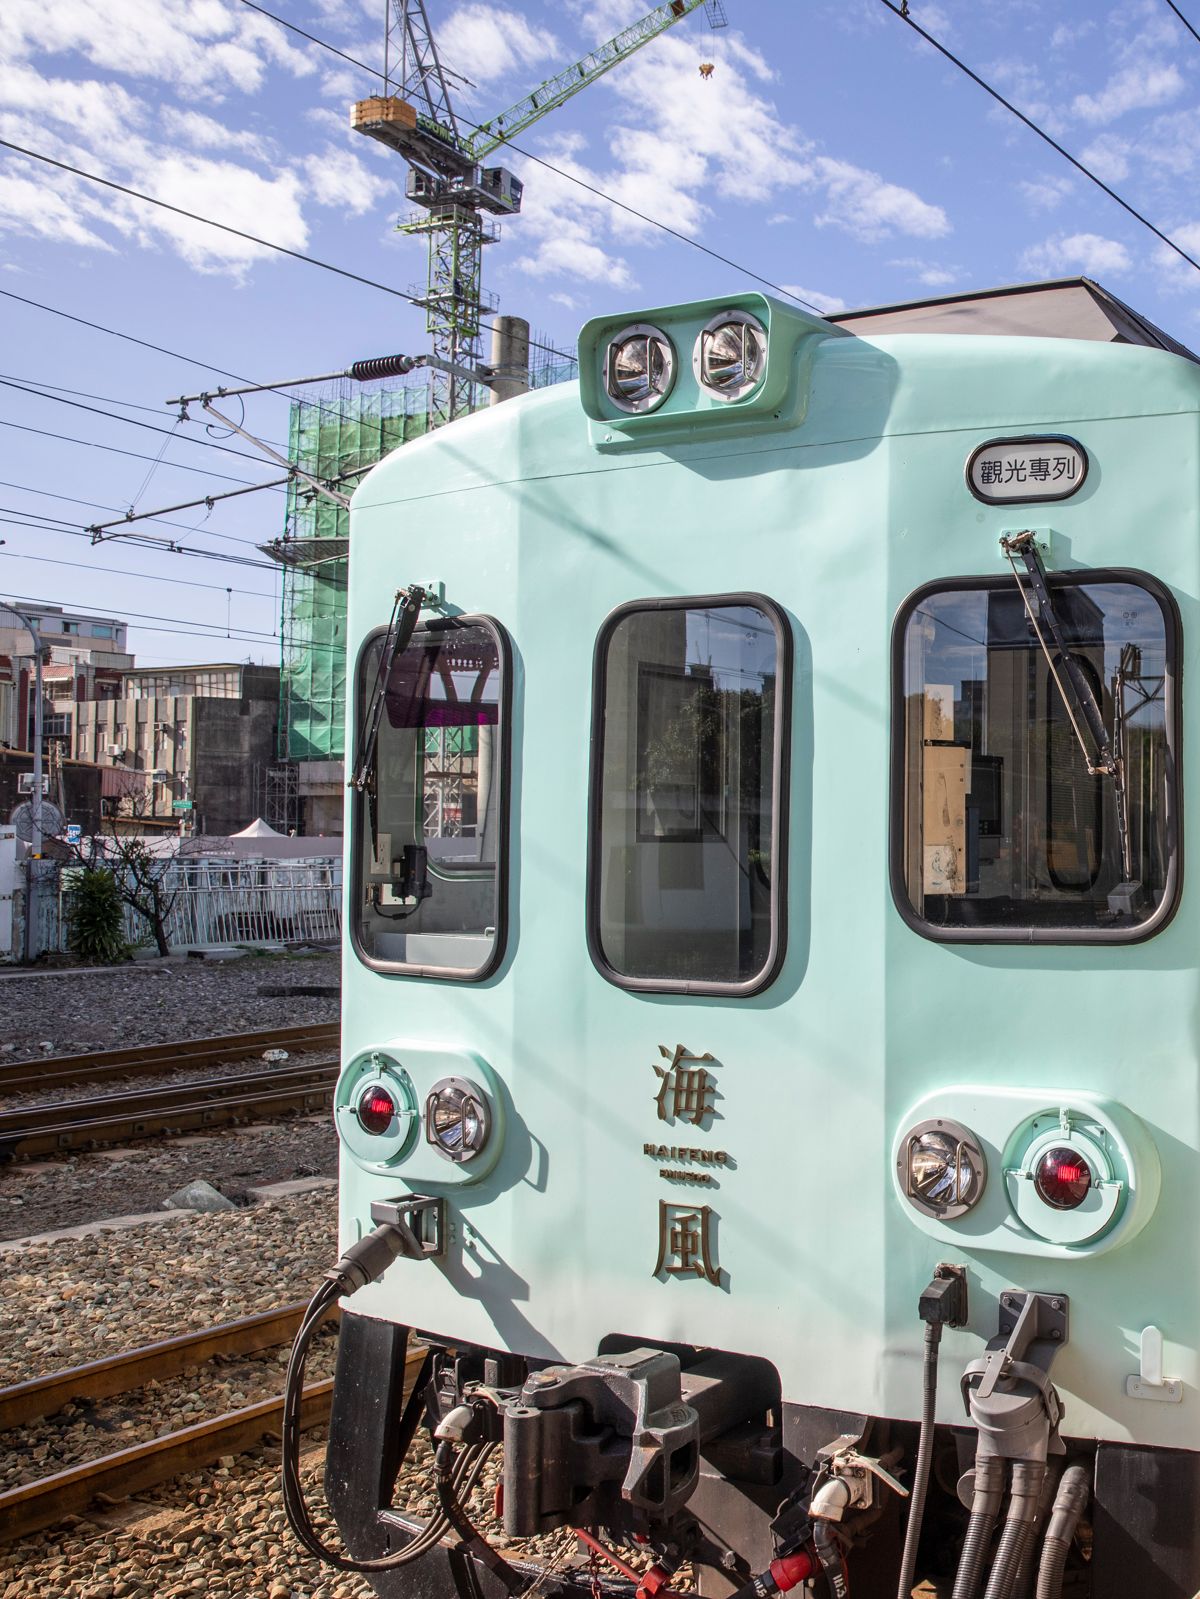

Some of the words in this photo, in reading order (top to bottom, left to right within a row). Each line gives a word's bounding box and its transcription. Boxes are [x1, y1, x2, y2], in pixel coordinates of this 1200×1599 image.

[980, 455, 1075, 485] 觀光專列
[652, 1043, 716, 1126] 海
[643, 1143, 728, 1165] HAIFENG
[652, 1198, 722, 1287] 風
